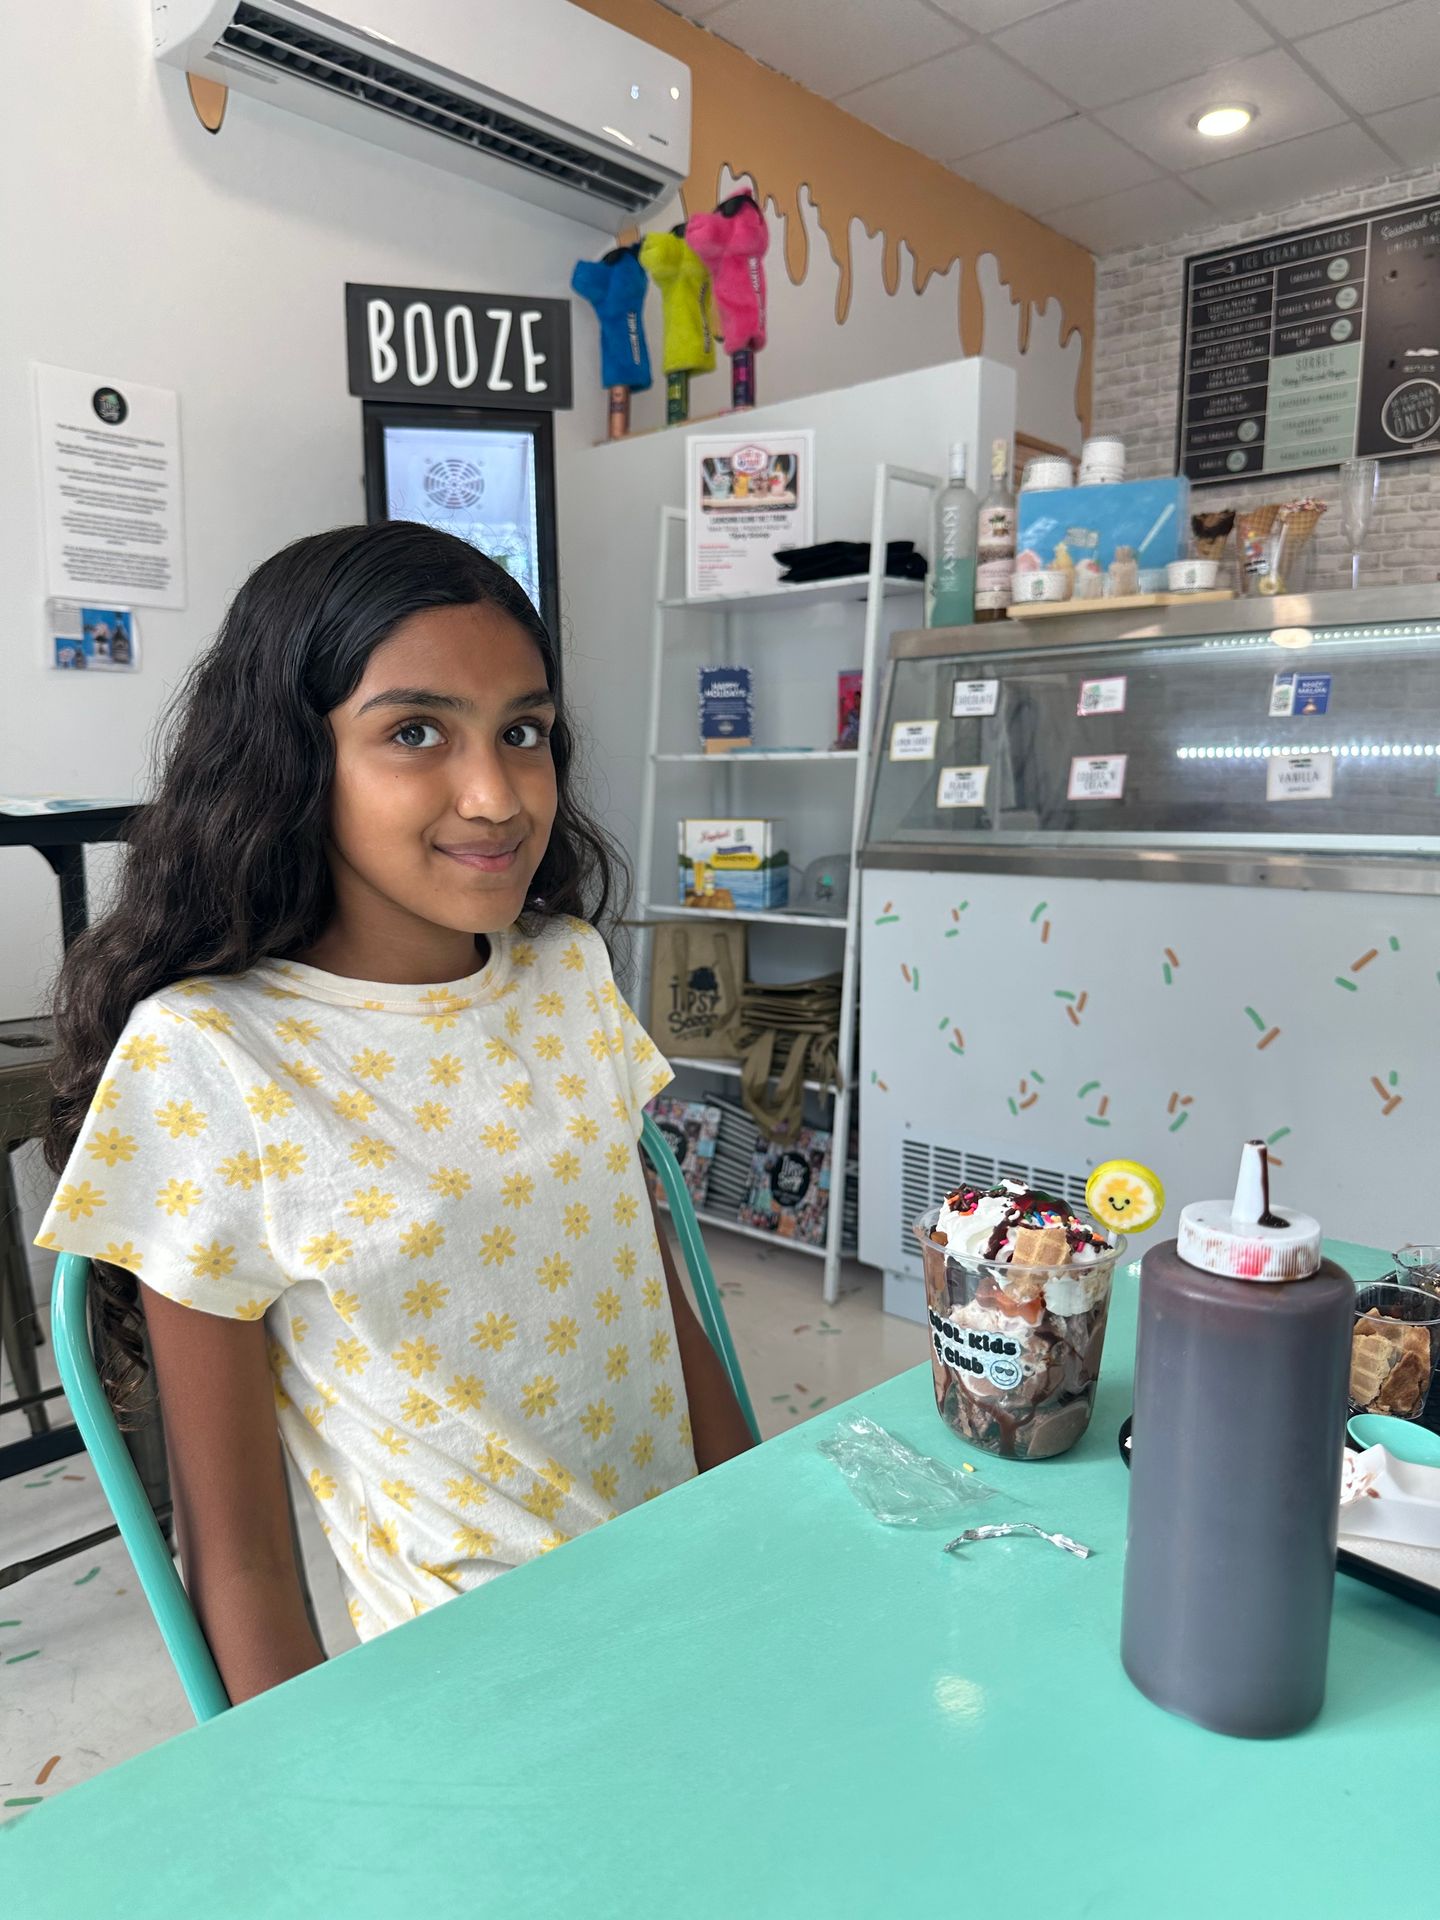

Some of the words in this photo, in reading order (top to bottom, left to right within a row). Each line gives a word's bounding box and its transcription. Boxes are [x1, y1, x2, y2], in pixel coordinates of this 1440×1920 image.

[1381, 214, 1428, 240] Seasonal
[1241, 253, 1259, 270] ICE
[1262, 243, 1298, 265] CREAM
[1301, 230, 1351, 255] FLAVORS
[367, 299, 548, 393] BOOZE
[1295, 351, 1334, 371] SORBET
[1394, 406, 1435, 437] ONLY
[943, 505, 960, 574] KINKY
[704, 688, 747, 698] HOLIDAYS
[711, 681, 741, 691] HAPPY
[954, 694, 994, 705] CHOCOLATE
[1278, 771, 1319, 784] VANILLA
[968, 1333, 1017, 1356] Kids
[944, 1346, 984, 1374] Club
